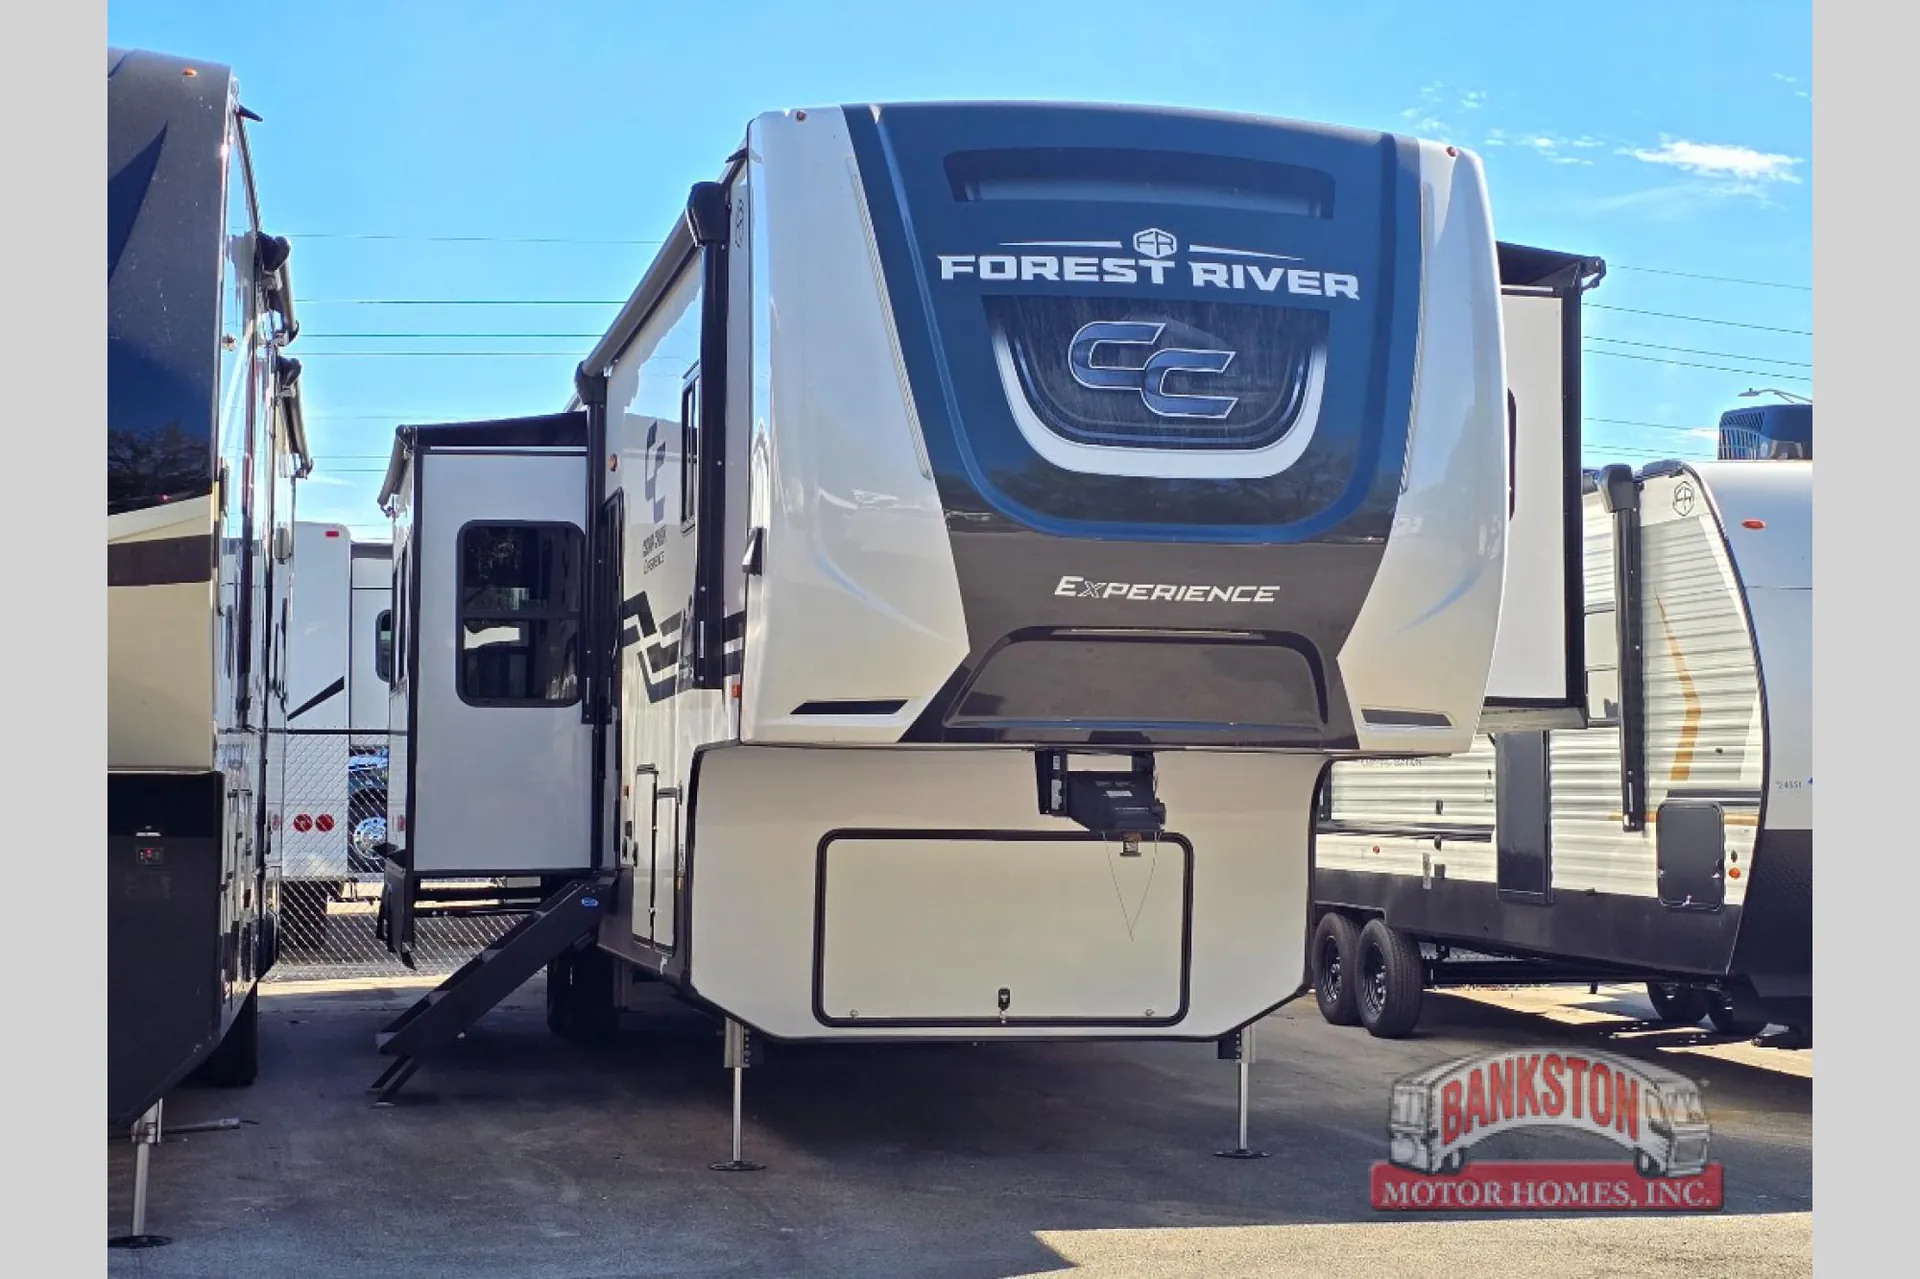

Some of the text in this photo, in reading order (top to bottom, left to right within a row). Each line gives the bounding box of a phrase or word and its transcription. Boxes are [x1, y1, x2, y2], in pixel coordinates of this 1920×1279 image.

[937, 254, 1360, 300] FOREST RIVER
[1054, 575, 1281, 603] EXPERIENCE
